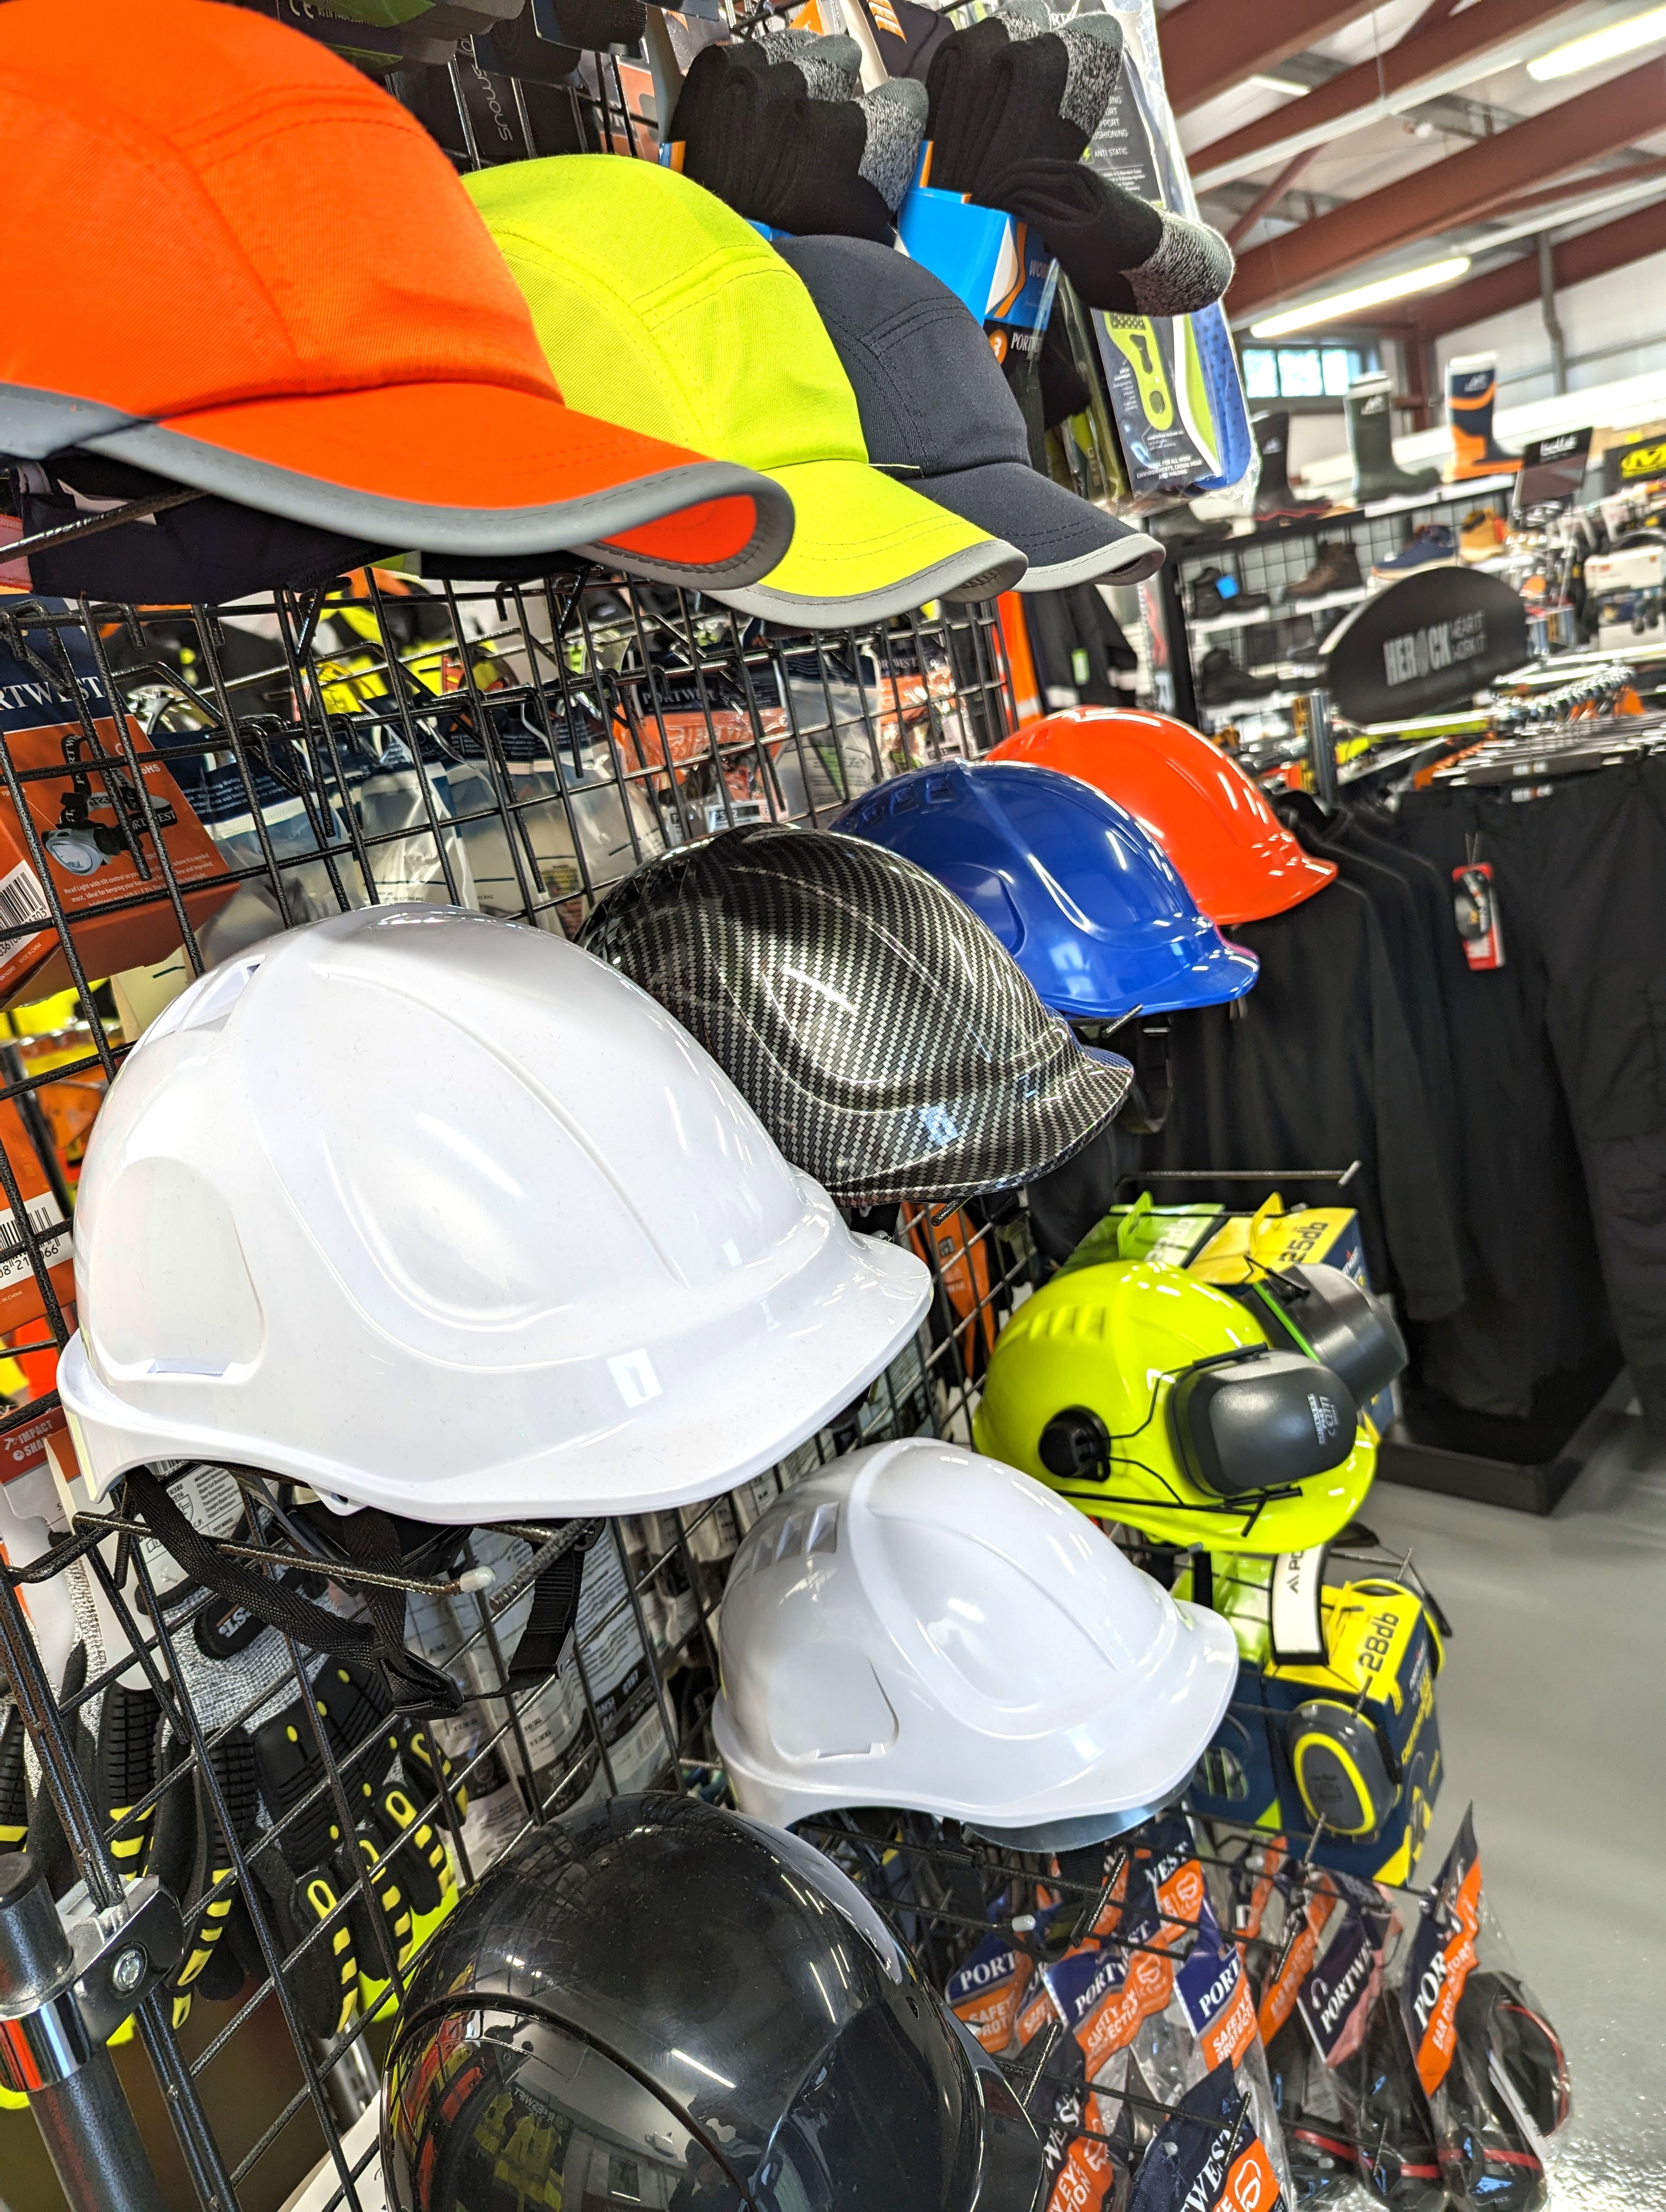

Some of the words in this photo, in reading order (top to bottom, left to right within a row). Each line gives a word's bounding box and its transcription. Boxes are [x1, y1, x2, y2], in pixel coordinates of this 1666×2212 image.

[1108, 147, 1129, 157] STATIC
[0, 677, 106, 711] RTWST
[141, 763, 162, 775] oHS
[714, 809, 739, 820] PS2
[63, 886, 77, 895] Head
[76, 883, 89, 892] Light
[108, 873, 125, 884] control
[71, 895, 86, 903] most.
[86, 891, 99, 899] Ideal
[105, 884, 125, 894] keeping
[30, 942, 42, 954] CHINA
[1277, 1221, 1329, 1264] 25db
[15, 1244, 59, 1270] 2166
[8, 1290, 23, 1300] CHINA
[1308, 1393, 1325, 1445] PORTWEST
[18, 1419, 53, 1444] IMPACT
[57, 1502, 62, 1512] 5
[213, 1524, 222, 1533] TEST
[1358, 1612, 1400, 1673] 28db
[960, 1952, 1016, 1992] PORT
[1199, 1956, 1239, 2018] PORT
